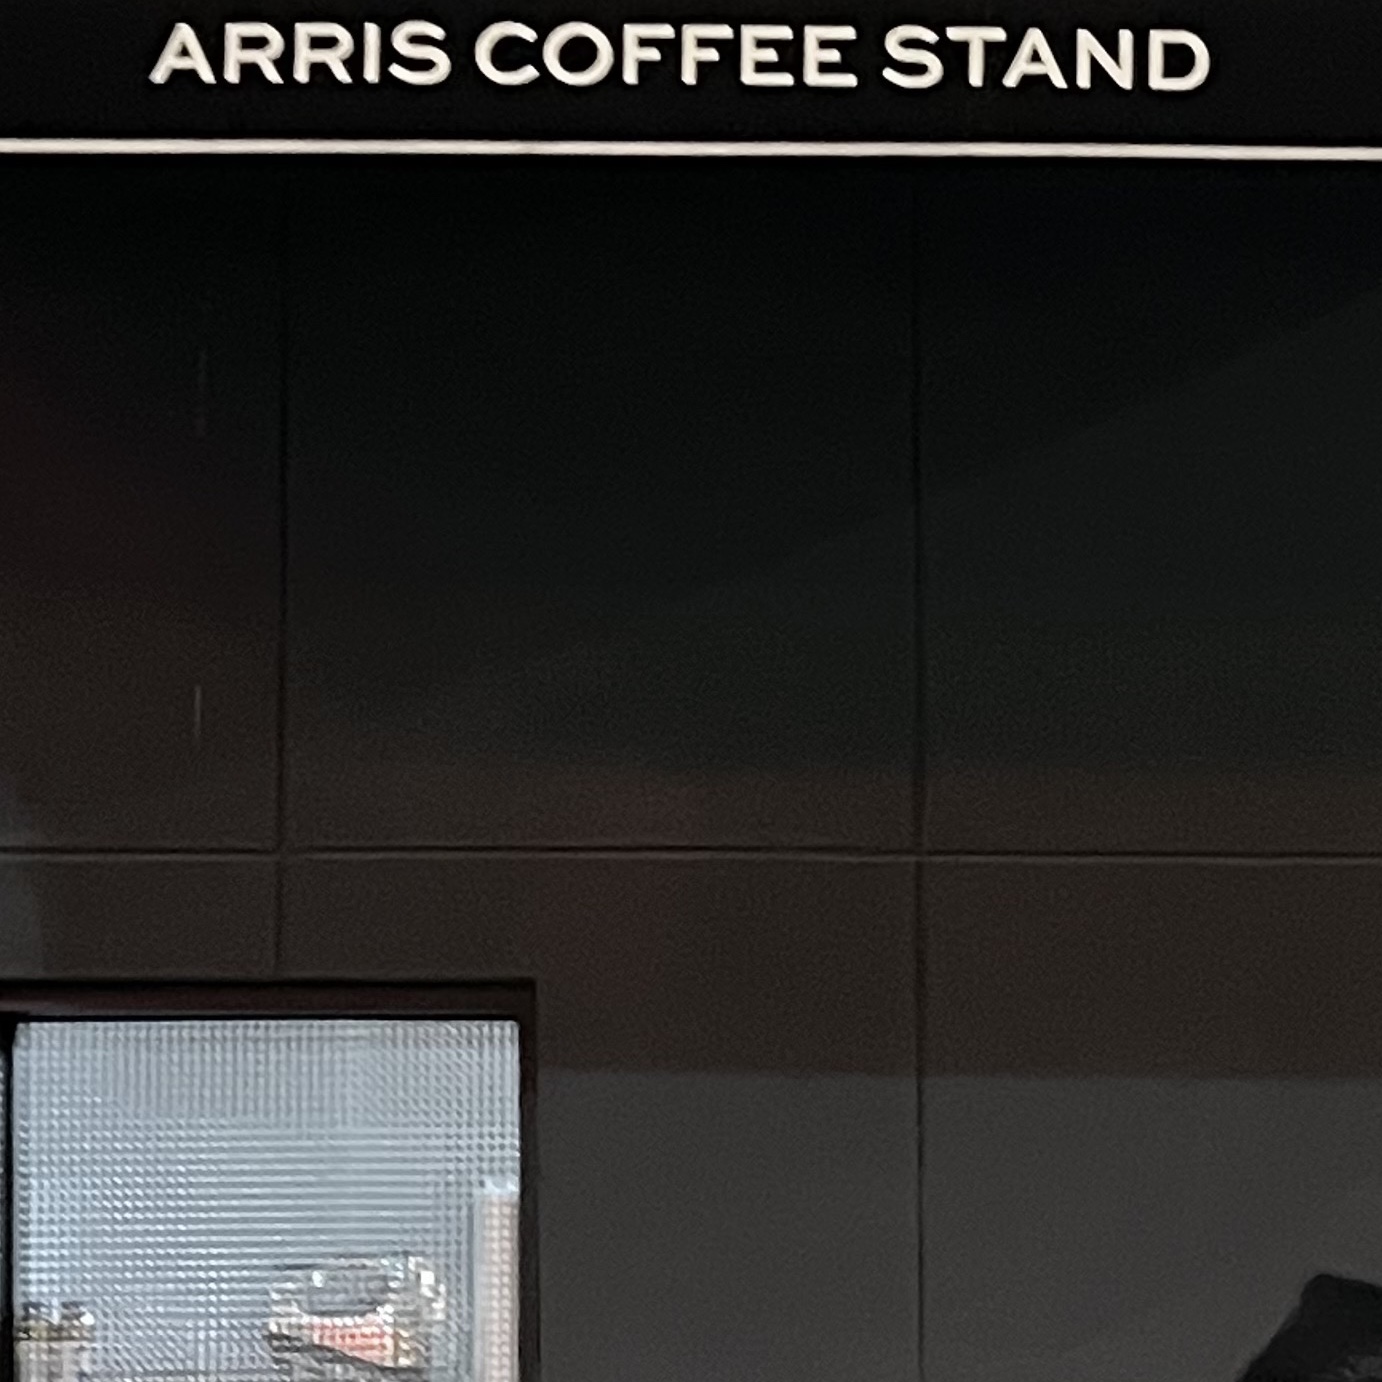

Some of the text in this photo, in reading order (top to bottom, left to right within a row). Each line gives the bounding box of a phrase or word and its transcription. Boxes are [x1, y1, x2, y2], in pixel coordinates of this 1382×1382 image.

[148, 20, 1211, 92] ARRIS COFFEE STAND
